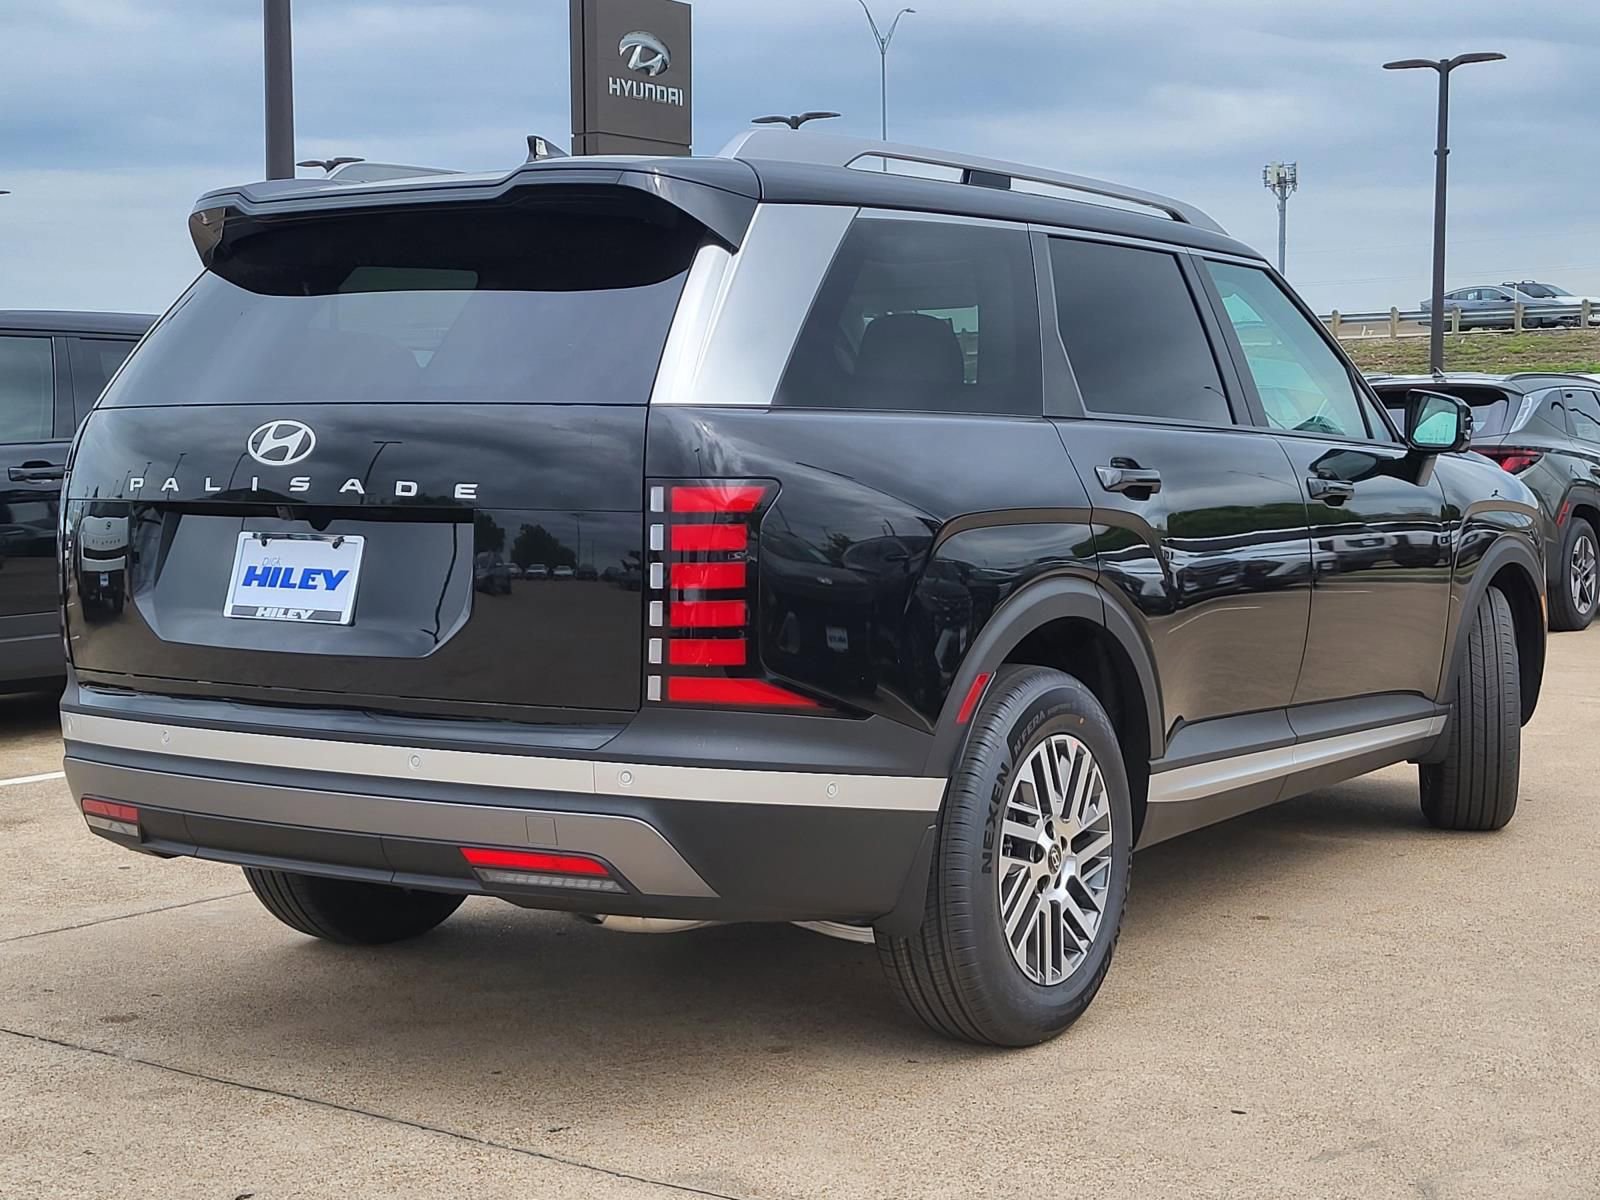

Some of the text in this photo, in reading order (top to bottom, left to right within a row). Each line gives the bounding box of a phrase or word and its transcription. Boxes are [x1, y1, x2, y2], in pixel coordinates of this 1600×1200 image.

[608, 76, 684, 107] HYUNDAI
[129, 476, 479, 499] PALISADE
[241, 565, 350, 591] HILEY
[255, 606, 315, 620] HILEY
[981, 762, 1011, 875] NEXEN
